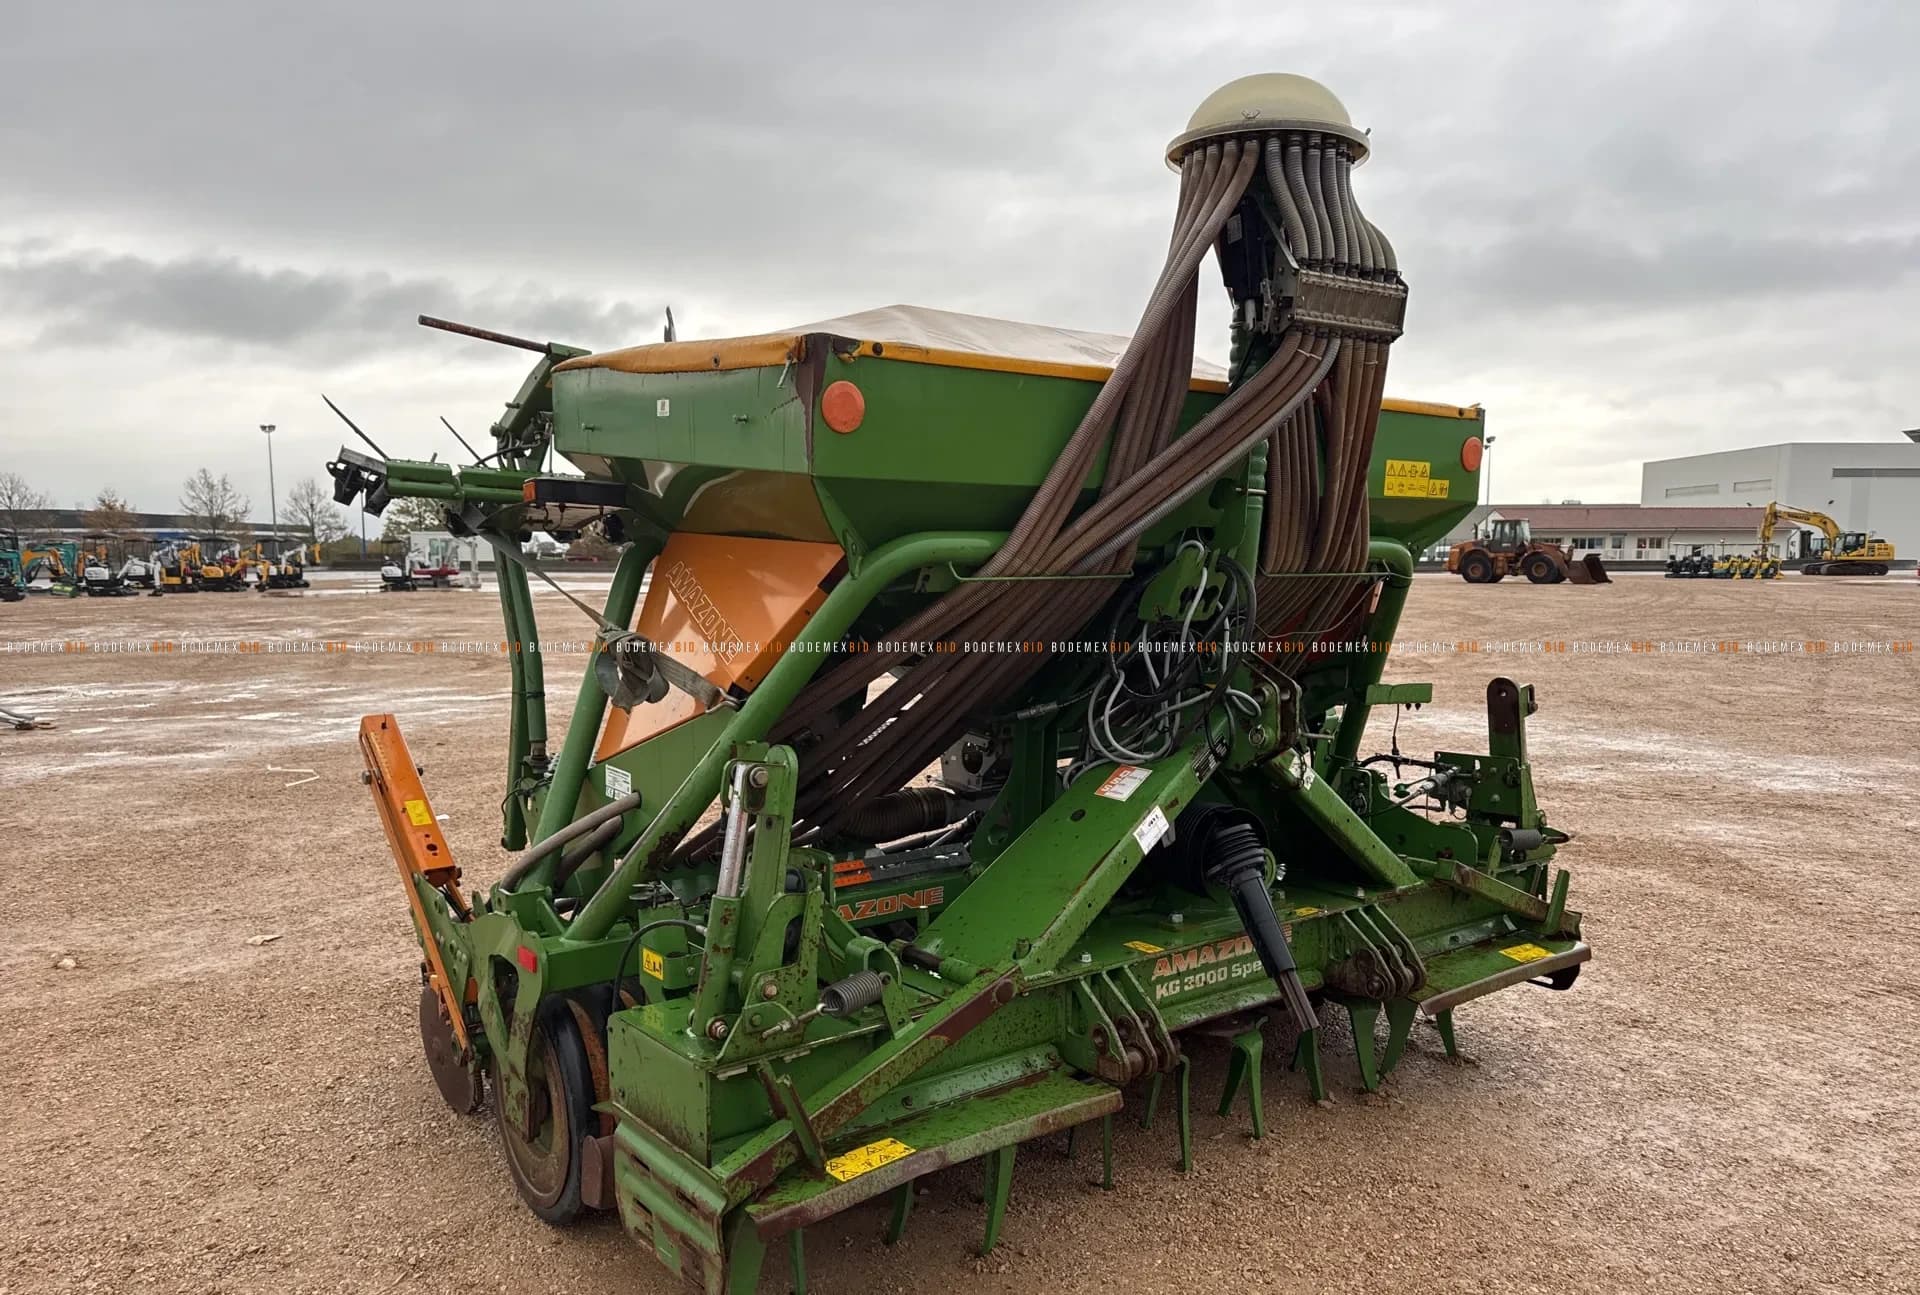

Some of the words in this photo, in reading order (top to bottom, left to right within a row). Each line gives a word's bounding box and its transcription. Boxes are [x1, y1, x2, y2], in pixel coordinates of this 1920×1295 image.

[665, 560, 743, 666] AMAZONE
[836, 886, 944, 921] AZONE
[1151, 923, 1292, 981] AMAZOE
[1156, 979, 1181, 999] KG
[1184, 966, 1228, 991] 3000
[1232, 959, 1263, 979] Spe
